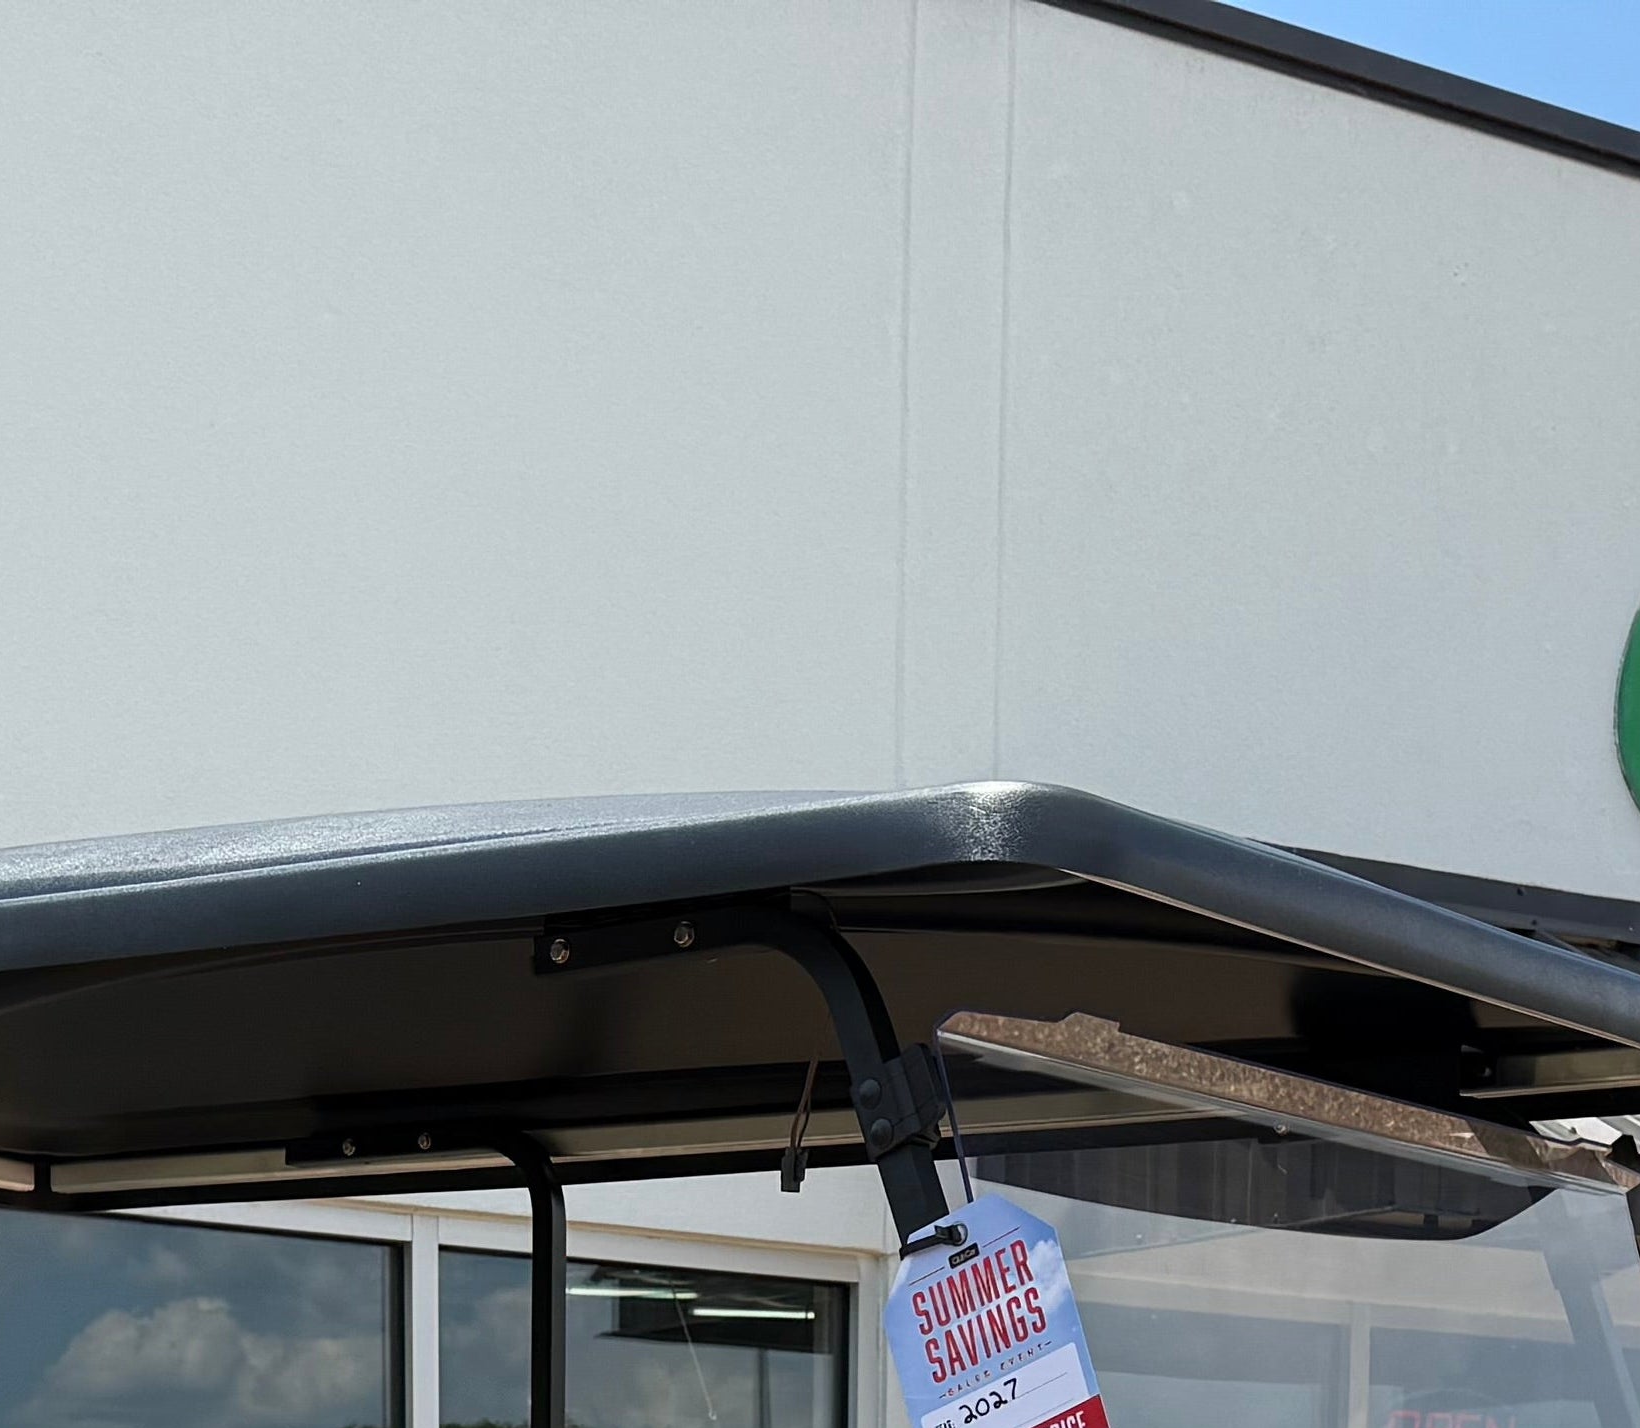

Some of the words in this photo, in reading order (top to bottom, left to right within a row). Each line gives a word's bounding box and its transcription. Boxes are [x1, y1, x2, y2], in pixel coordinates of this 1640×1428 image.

[912, 1239, 1035, 1336] SUMMER
[924, 1287, 1047, 1384] SAVINGS
[958, 1377, 1018, 1424] 2027
